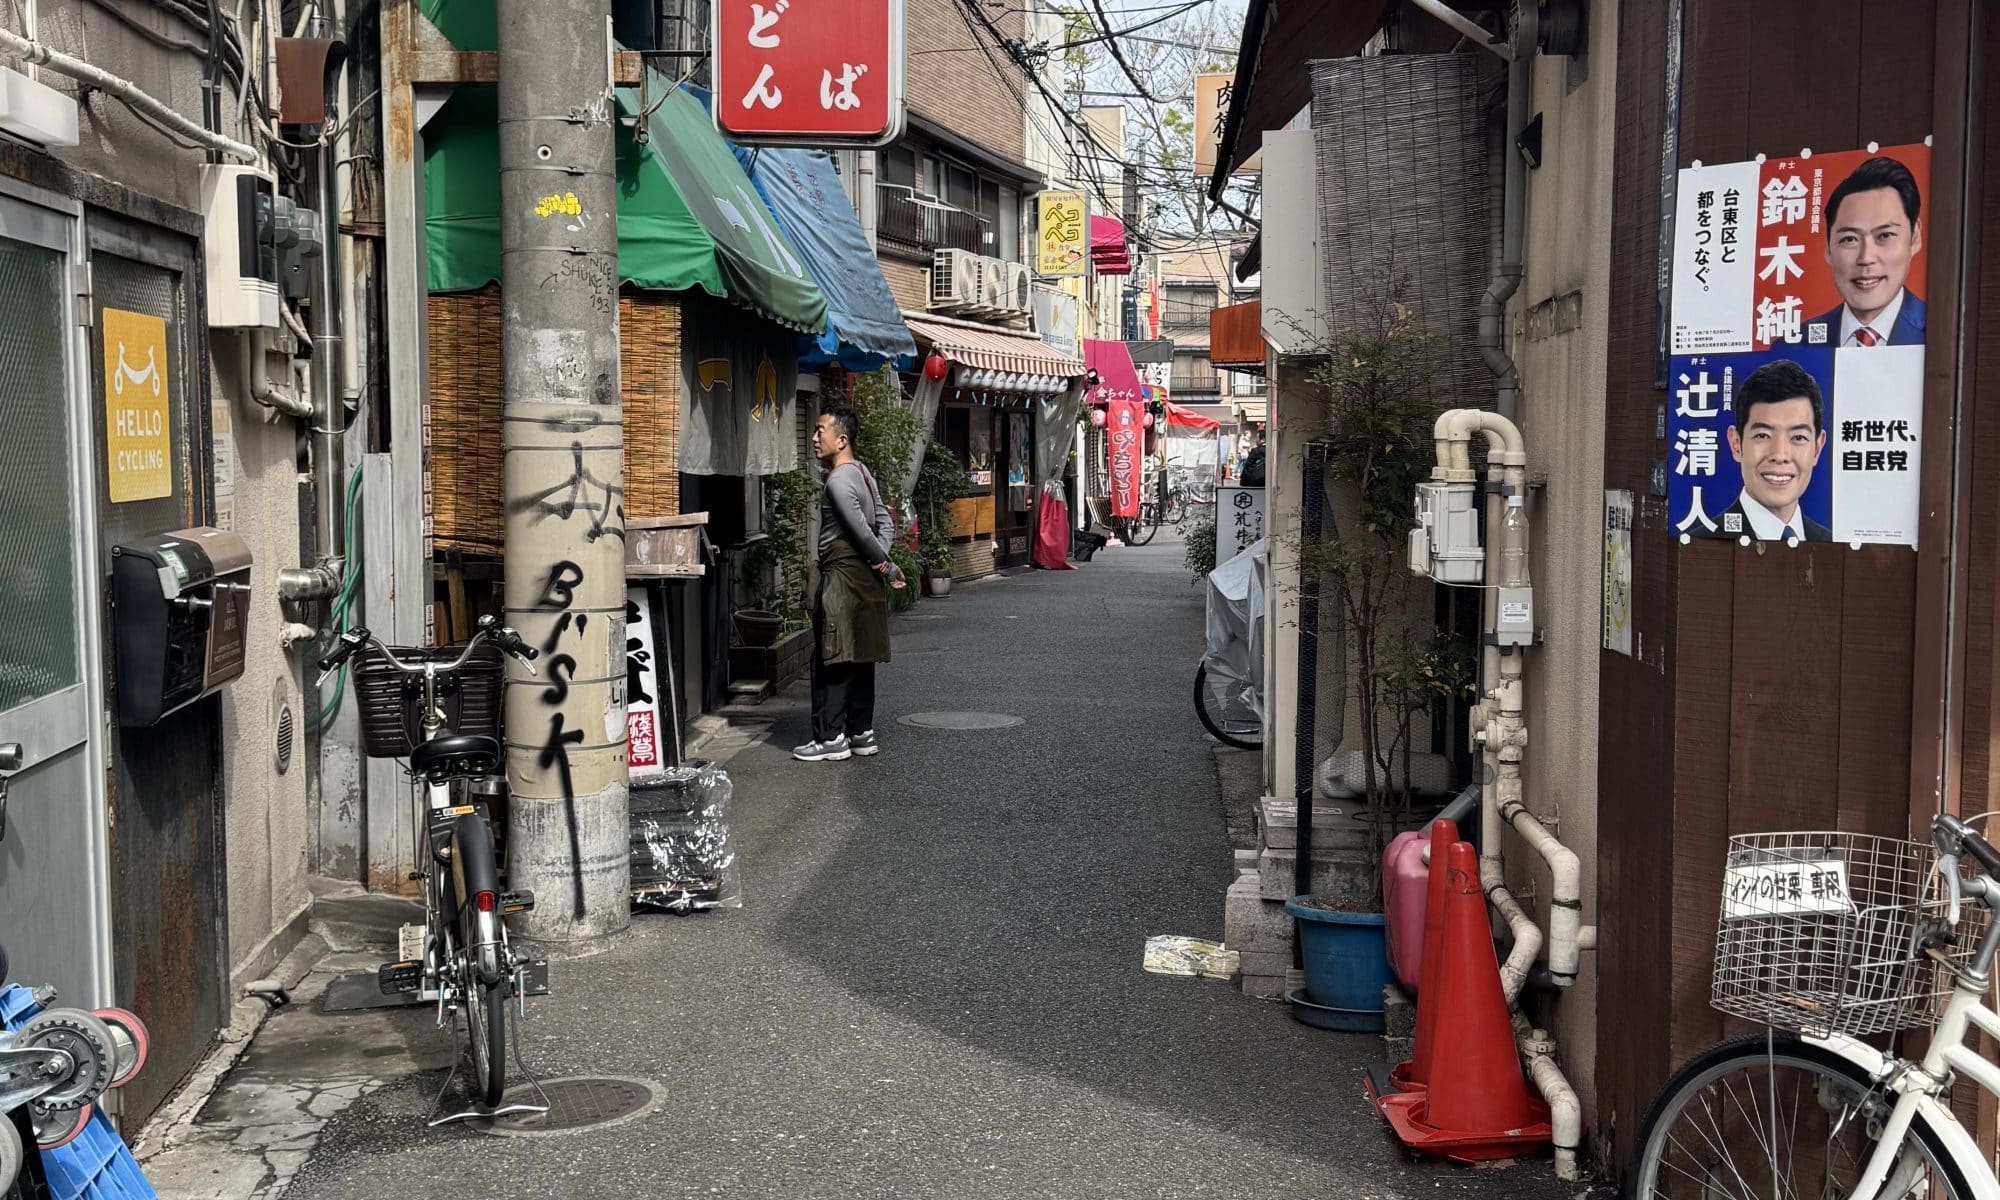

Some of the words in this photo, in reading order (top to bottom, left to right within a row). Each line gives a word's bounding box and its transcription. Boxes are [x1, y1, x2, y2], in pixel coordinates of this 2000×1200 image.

[819, 62, 868, 111] ば
[1778, 160, 1796, 170] 弁士
[1045, 202, 1080, 223] ペコ
[1811, 168, 1824, 234] 東京都議会議員
[1045, 222, 1080, 243] ペコ
[1720, 188, 1740, 264] 台東区と
[1694, 190, 1715, 293] 都をつなぐ。
[1756, 174, 1809, 346] 鈴木純
[1690, 357, 1707, 366] 弁士
[1096, 386, 1135, 398] 金ちゃん
[116, 409, 162, 437] HELLO
[1841, 419, 1918, 443] 新世代、
[118, 449, 163, 472] CYCLING
[1675, 371, 1719, 534] 辻清人
[1841, 449, 1908, 472] 自民党
[1112, 429, 1135, 511] やきとり
[1731, 872, 1802, 905] イシイの甘栗
[1810, 870, 1842, 900] 専用
